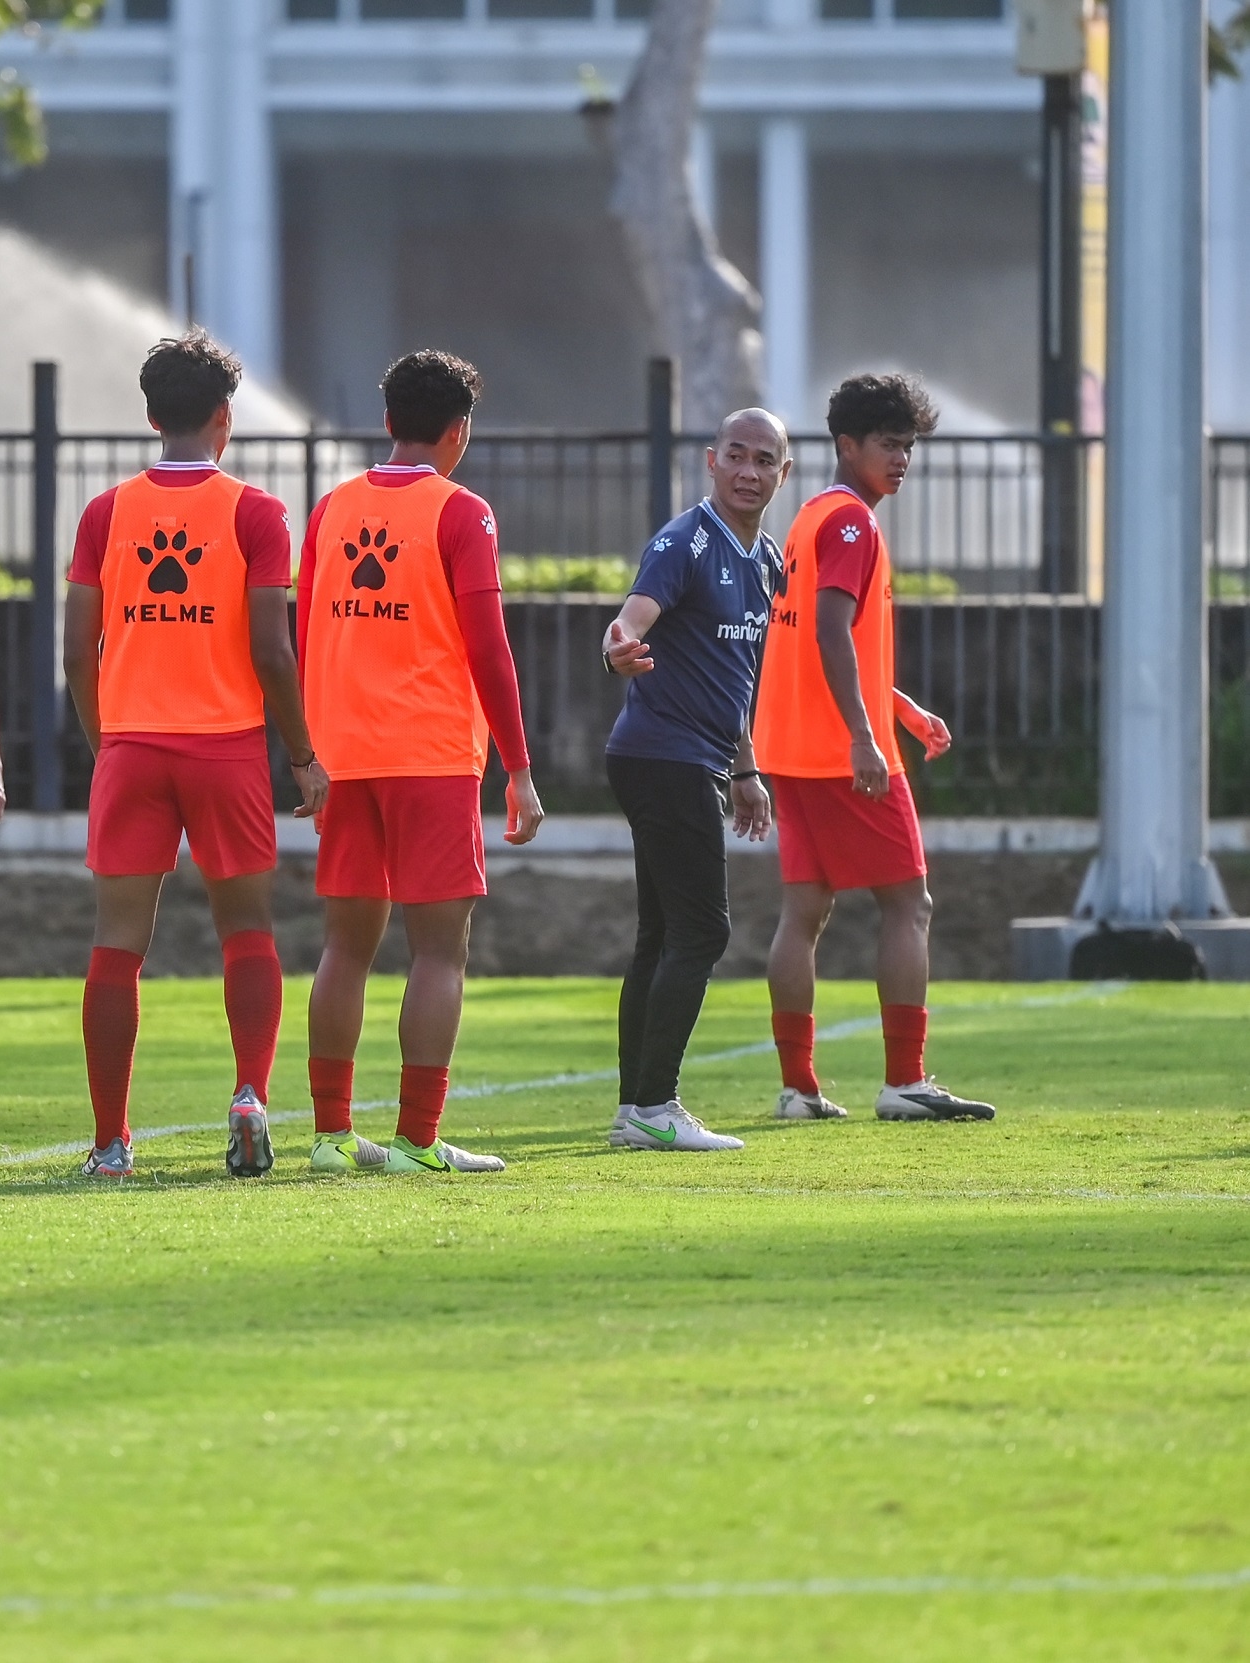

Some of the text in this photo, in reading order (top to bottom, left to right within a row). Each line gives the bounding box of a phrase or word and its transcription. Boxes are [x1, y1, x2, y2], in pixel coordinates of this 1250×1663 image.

[689, 524, 710, 560] AQUA
[123, 603, 215, 624] KELME
[332, 599, 410, 621] KELME
